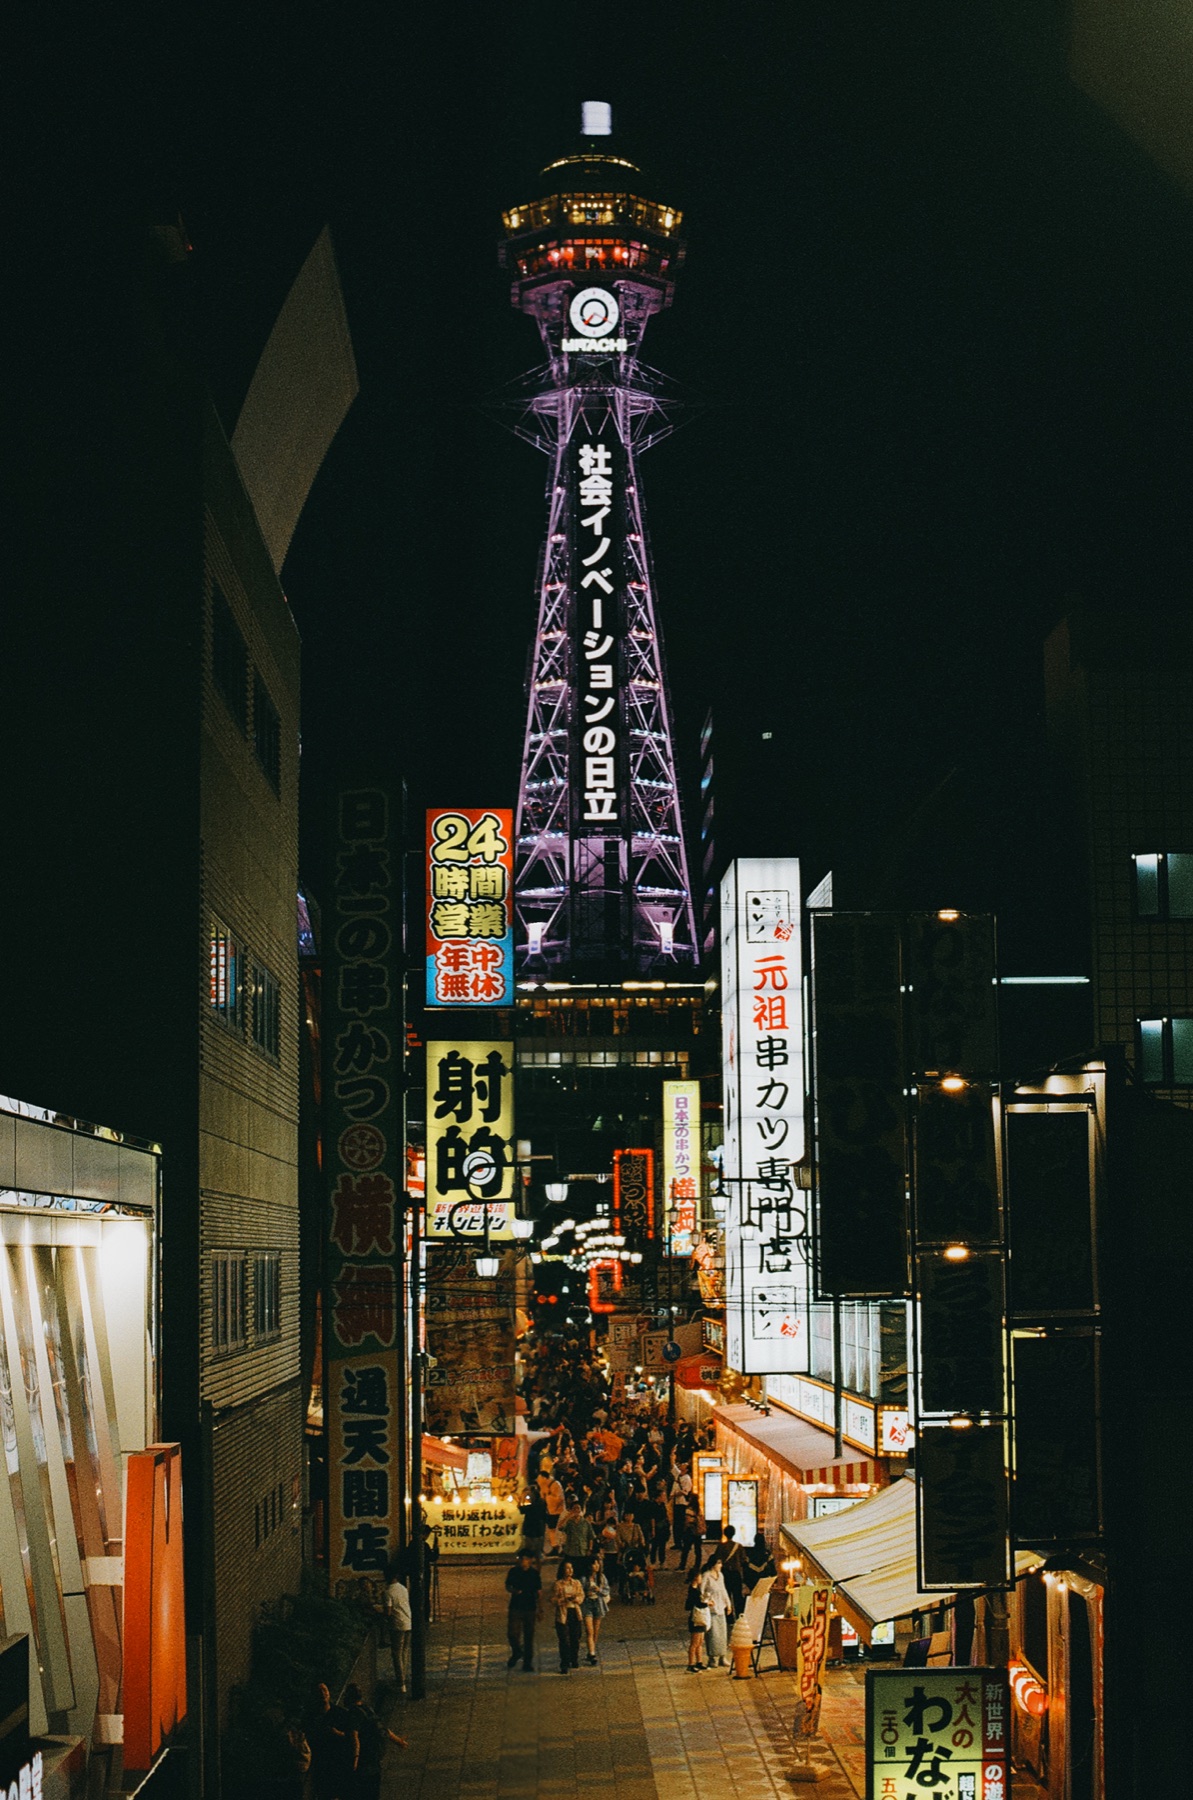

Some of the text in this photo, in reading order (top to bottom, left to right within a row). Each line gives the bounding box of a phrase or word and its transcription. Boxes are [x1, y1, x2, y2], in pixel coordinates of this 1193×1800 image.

[578, 444, 618, 820] 社会イノベーションの日立
[432, 814, 507, 863] 24
[432, 865, 506, 900] 時間
[431, 901, 507, 939] 営業
[438, 944, 502, 972] 年中
[439, 972, 502, 998] 無休
[434, 1050, 506, 1198] 射的
[952, 1682, 978, 1749] 大人の
[903, 1686, 954, 1800] わな
